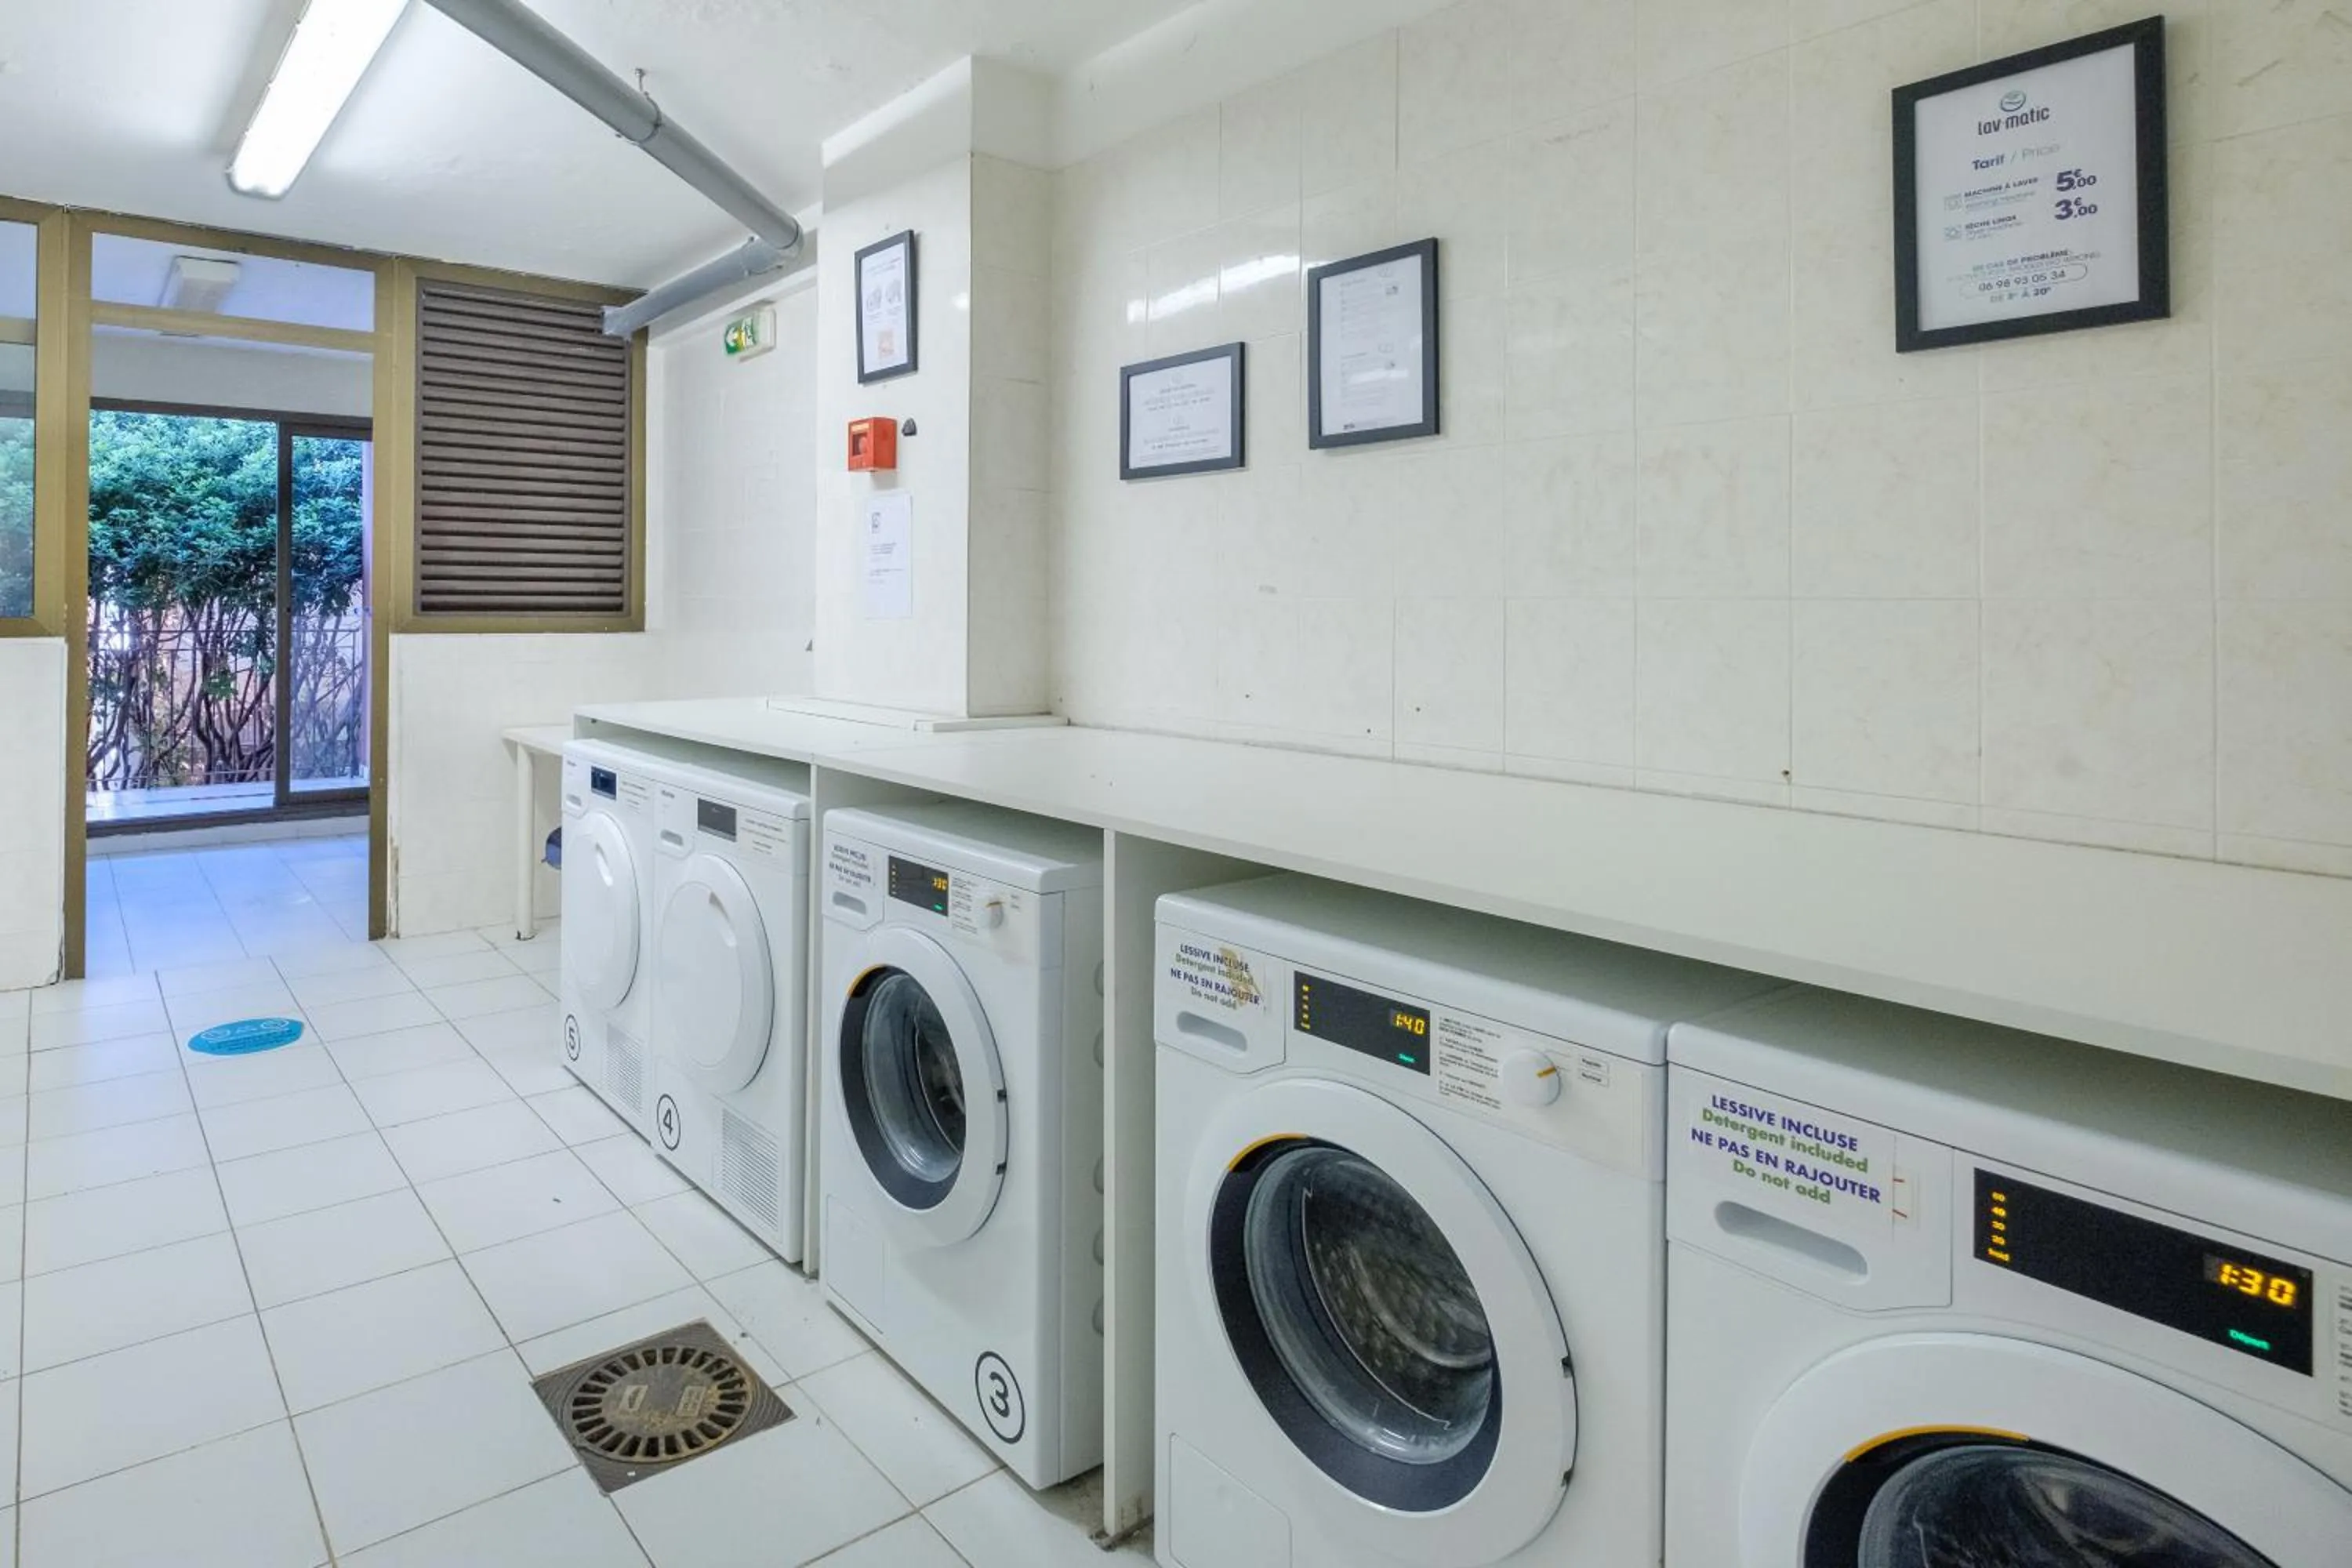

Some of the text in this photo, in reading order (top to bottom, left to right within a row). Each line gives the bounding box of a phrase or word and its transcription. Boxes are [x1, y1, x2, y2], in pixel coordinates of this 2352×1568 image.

[1972, 154, 2005, 171] Tarif
[1180, 943, 1211, 961] LESSIVE
[1171, 967, 1260, 1004] NE PAS EN RAJOUTER
[1393, 1012, 1425, 1036] 1:40
[662, 1107, 674, 1136] 4
[1702, 1107, 1868, 1174] Detergent included
[1711, 1094, 1858, 1152] LESSIVE INCLUSE
[1691, 1127, 1882, 1204] NE PAS EN RAJOUTER
[1733, 1159, 1832, 1205] Do not add
[2220, 1263, 2297, 1308] 1:30
[989, 1370, 1011, 1418] 3
